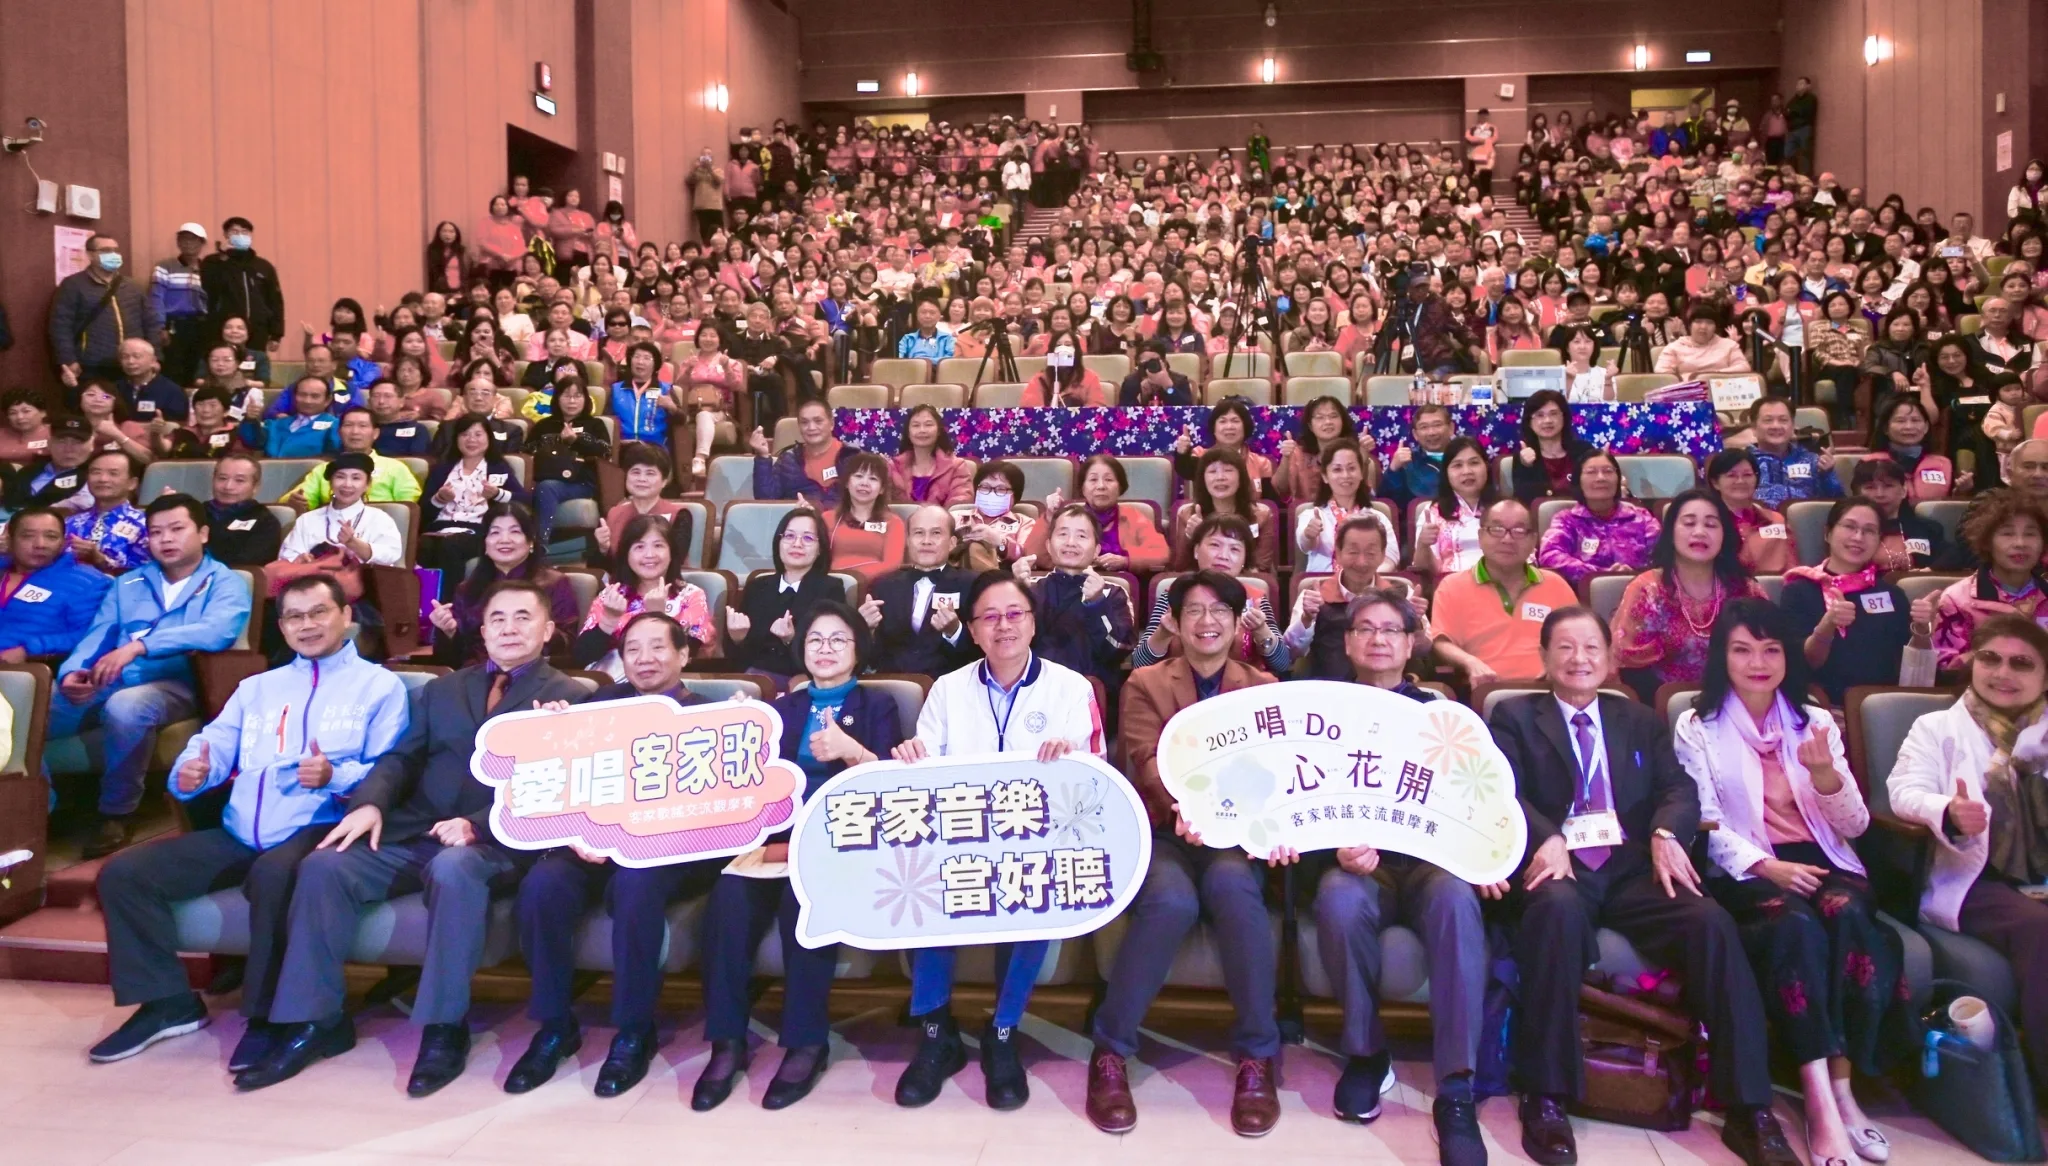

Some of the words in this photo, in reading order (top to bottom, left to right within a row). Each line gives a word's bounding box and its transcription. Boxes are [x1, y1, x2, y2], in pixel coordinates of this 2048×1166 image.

[1791, 467, 1807, 476] 112
[1923, 472, 1943, 482] 113
[1000, 524, 1013, 532] 93
[1765, 526, 1781, 536] 99
[1909, 541, 1927, 552] 100
[1528, 606, 1545, 619] 85
[1867, 597, 1885, 610] 87
[1206, 726, 1248, 751] 2023
[1254, 705, 1287, 739] 唱
[1306, 712, 1341, 740] Do
[510, 720, 764, 818] 愛唱客家歌
[1287, 750, 1434, 805] 心花開
[628, 795, 755, 825] 客家歌謠交流觀摩賽
[825, 778, 1050, 852] 客家音樂
[1290, 804, 1439, 837] 客家歌謠交流觀摩賽
[940, 847, 1113, 918] 當好聽
